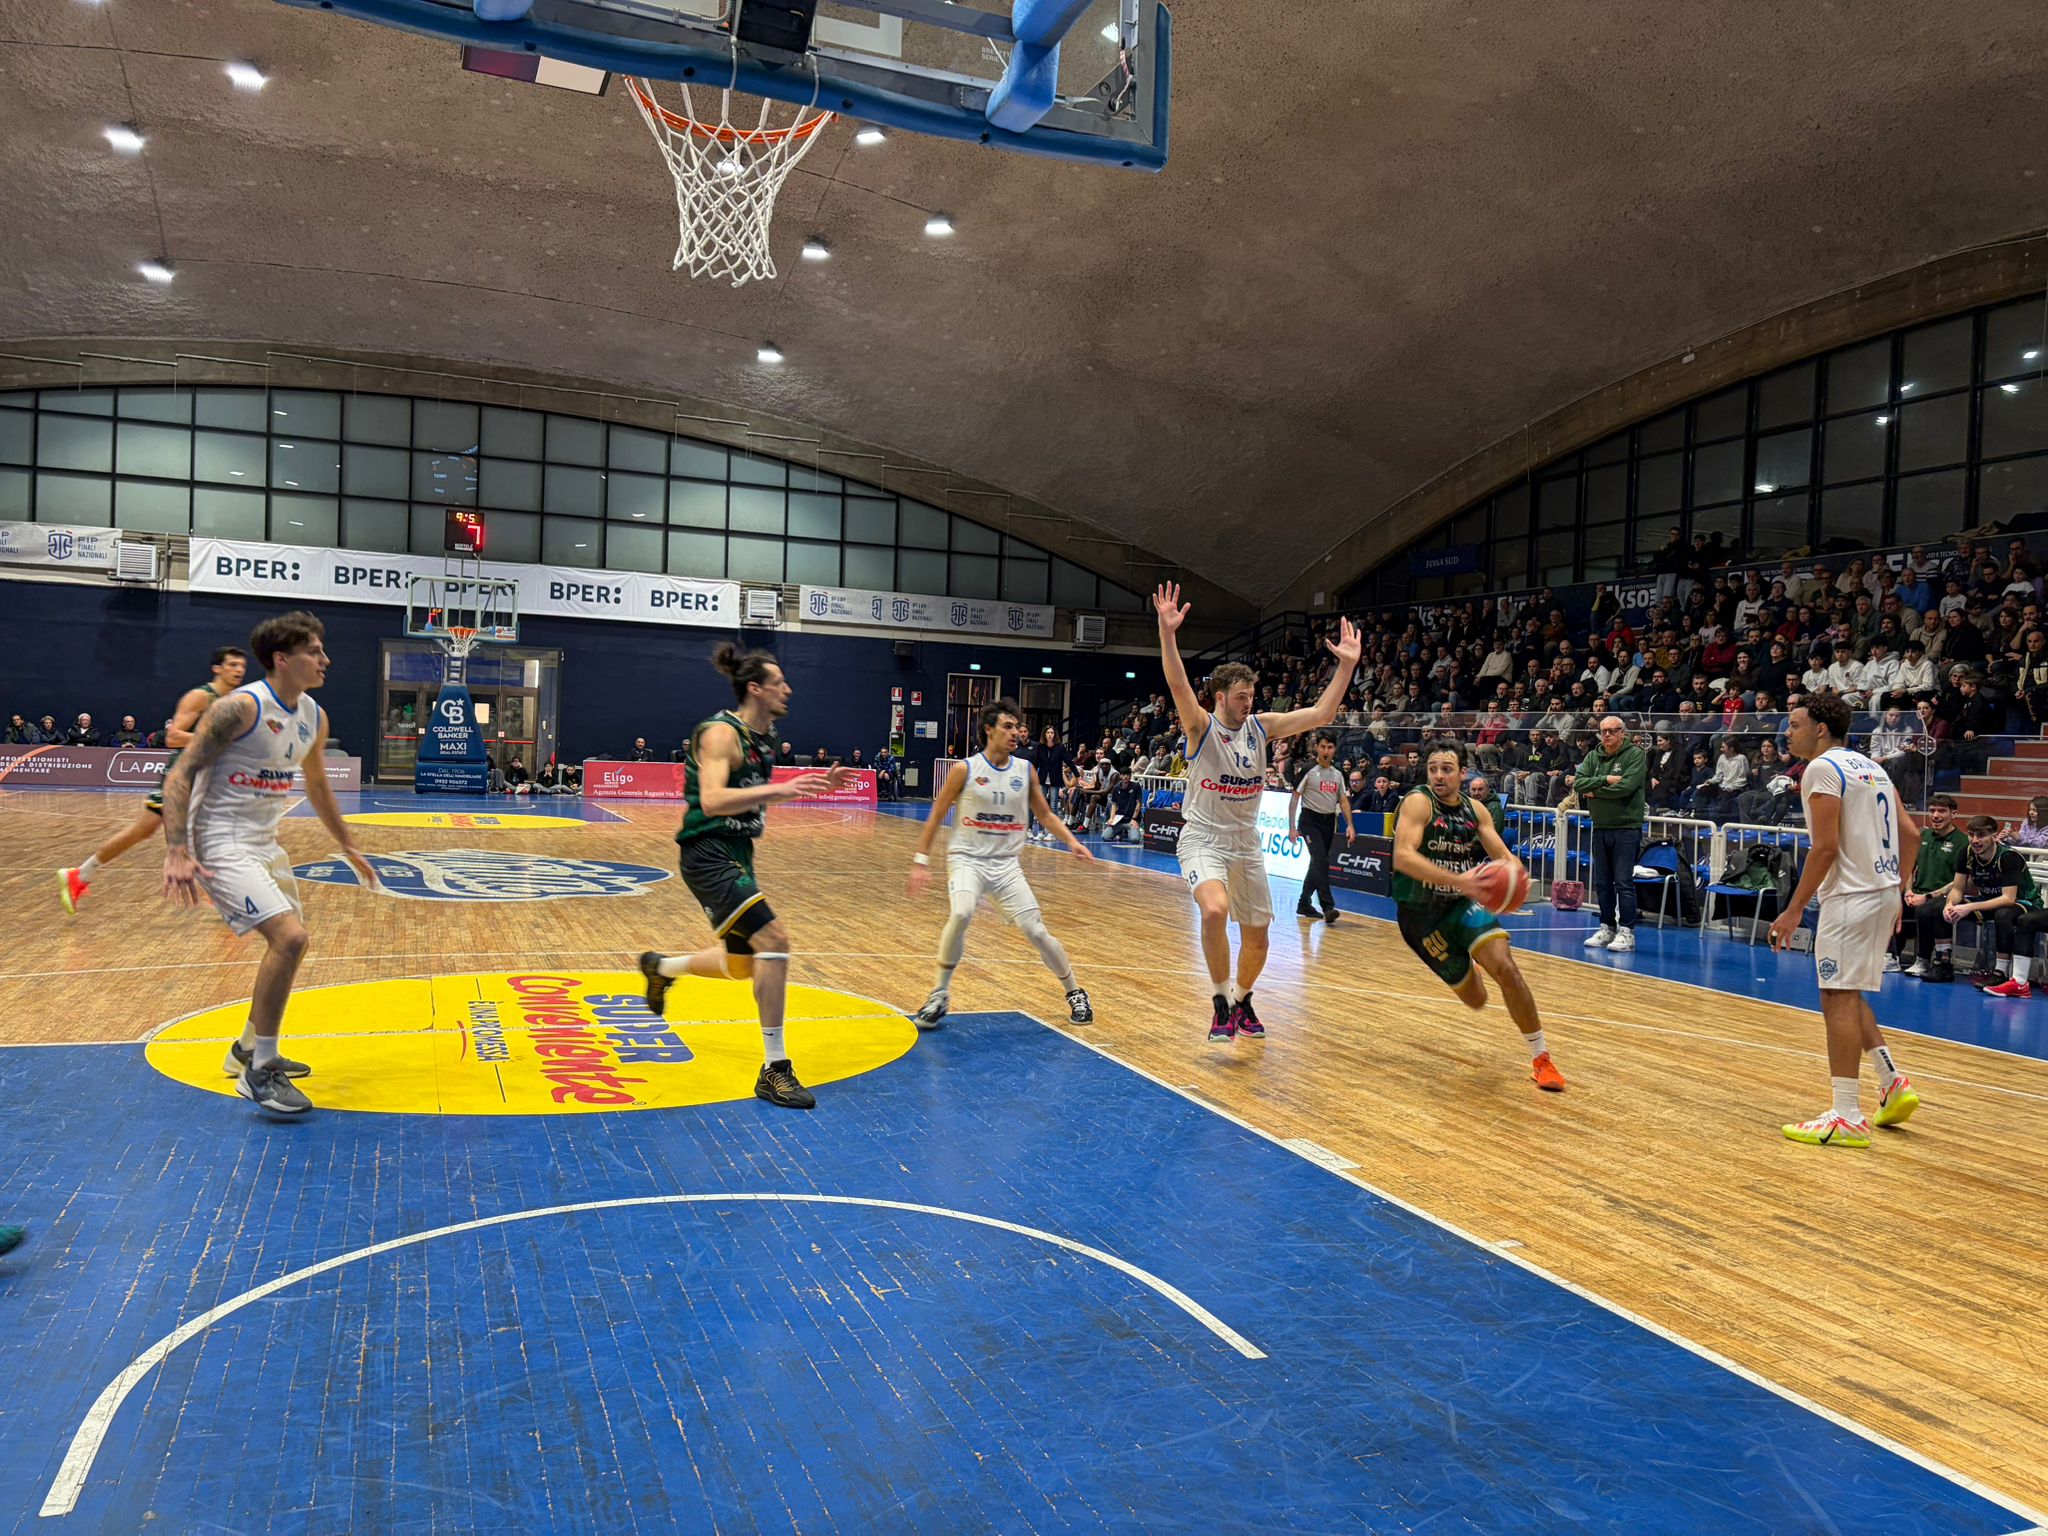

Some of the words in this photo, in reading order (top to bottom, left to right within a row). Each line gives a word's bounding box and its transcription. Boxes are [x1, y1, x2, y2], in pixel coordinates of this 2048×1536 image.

[467, 525, 481, 545] 7
[1444, 555, 1459, 566] SUD
[440, 742, 467, 750] MAXI
[603, 771, 634, 784] Eligo
[1219, 774, 1263, 786] SUPER
[992, 791, 1005, 805] 11
[1149, 823, 1179, 837] C-HR
[1337, 853, 1381, 871] C-HR
[245, 895, 259, 915] 4
[583, 993, 695, 1063] SUPER
[506, 975, 648, 1105] Conveniente
